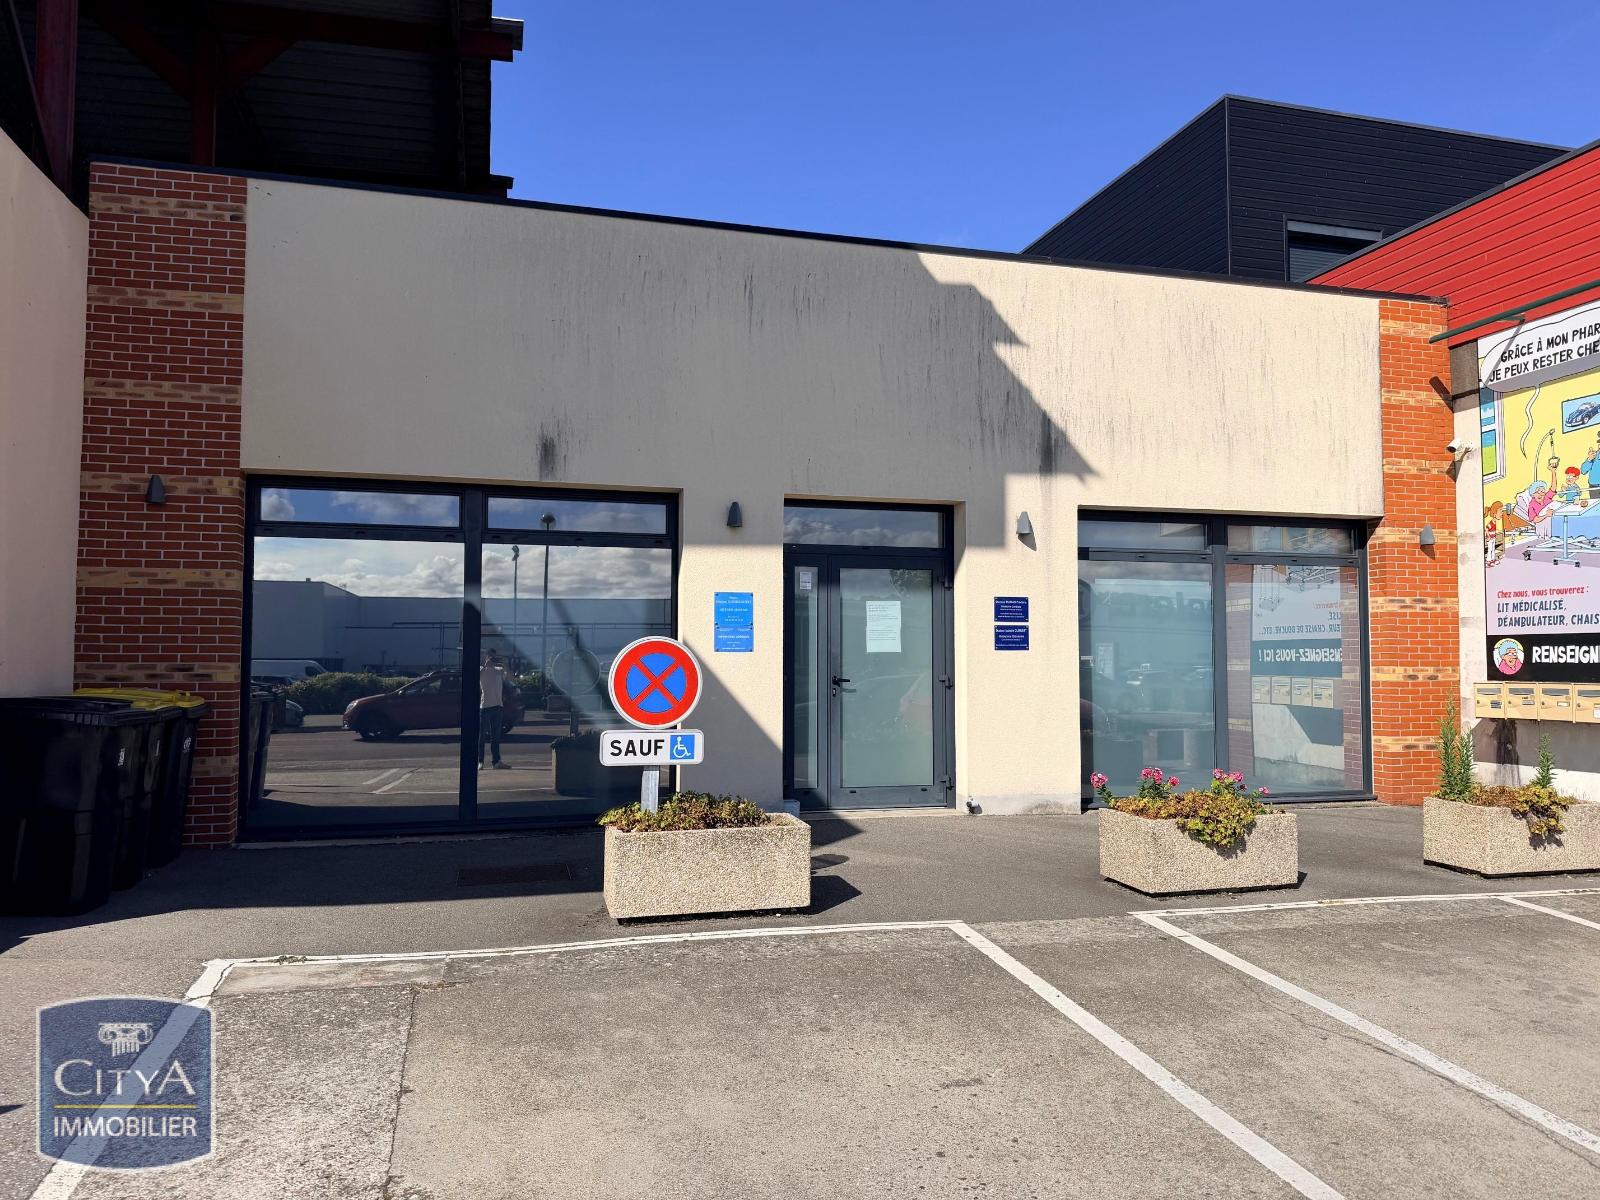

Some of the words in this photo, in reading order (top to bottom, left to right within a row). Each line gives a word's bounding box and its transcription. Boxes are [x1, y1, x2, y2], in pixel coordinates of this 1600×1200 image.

[1500, 342, 1534, 363] GRÂCE
[1536, 337, 1543, 352] À
[1546, 331, 1569, 350] MON
[1572, 322, 1600, 342] PHAR
[1489, 369, 1502, 382] JE
[1504, 361, 1530, 378] PEUX
[1532, 348, 1574, 371] RESTER
[1577, 340, 1600, 357] CHE
[1497, 590, 1512, 599] Chez
[1531, 588, 1548, 597] vous
[1549, 586, 1585, 596] trouverez
[1497, 602, 1510, 613] LIT
[1511, 598, 1567, 612] MÉDICALISÉ,
[1497, 614, 1568, 628] DÉAMBULATEUR,
[1570, 613, 1600, 625] CHAIS
[1532, 645, 1600, 664] RENSEIGN
[610, 739, 665, 757] SAUF
